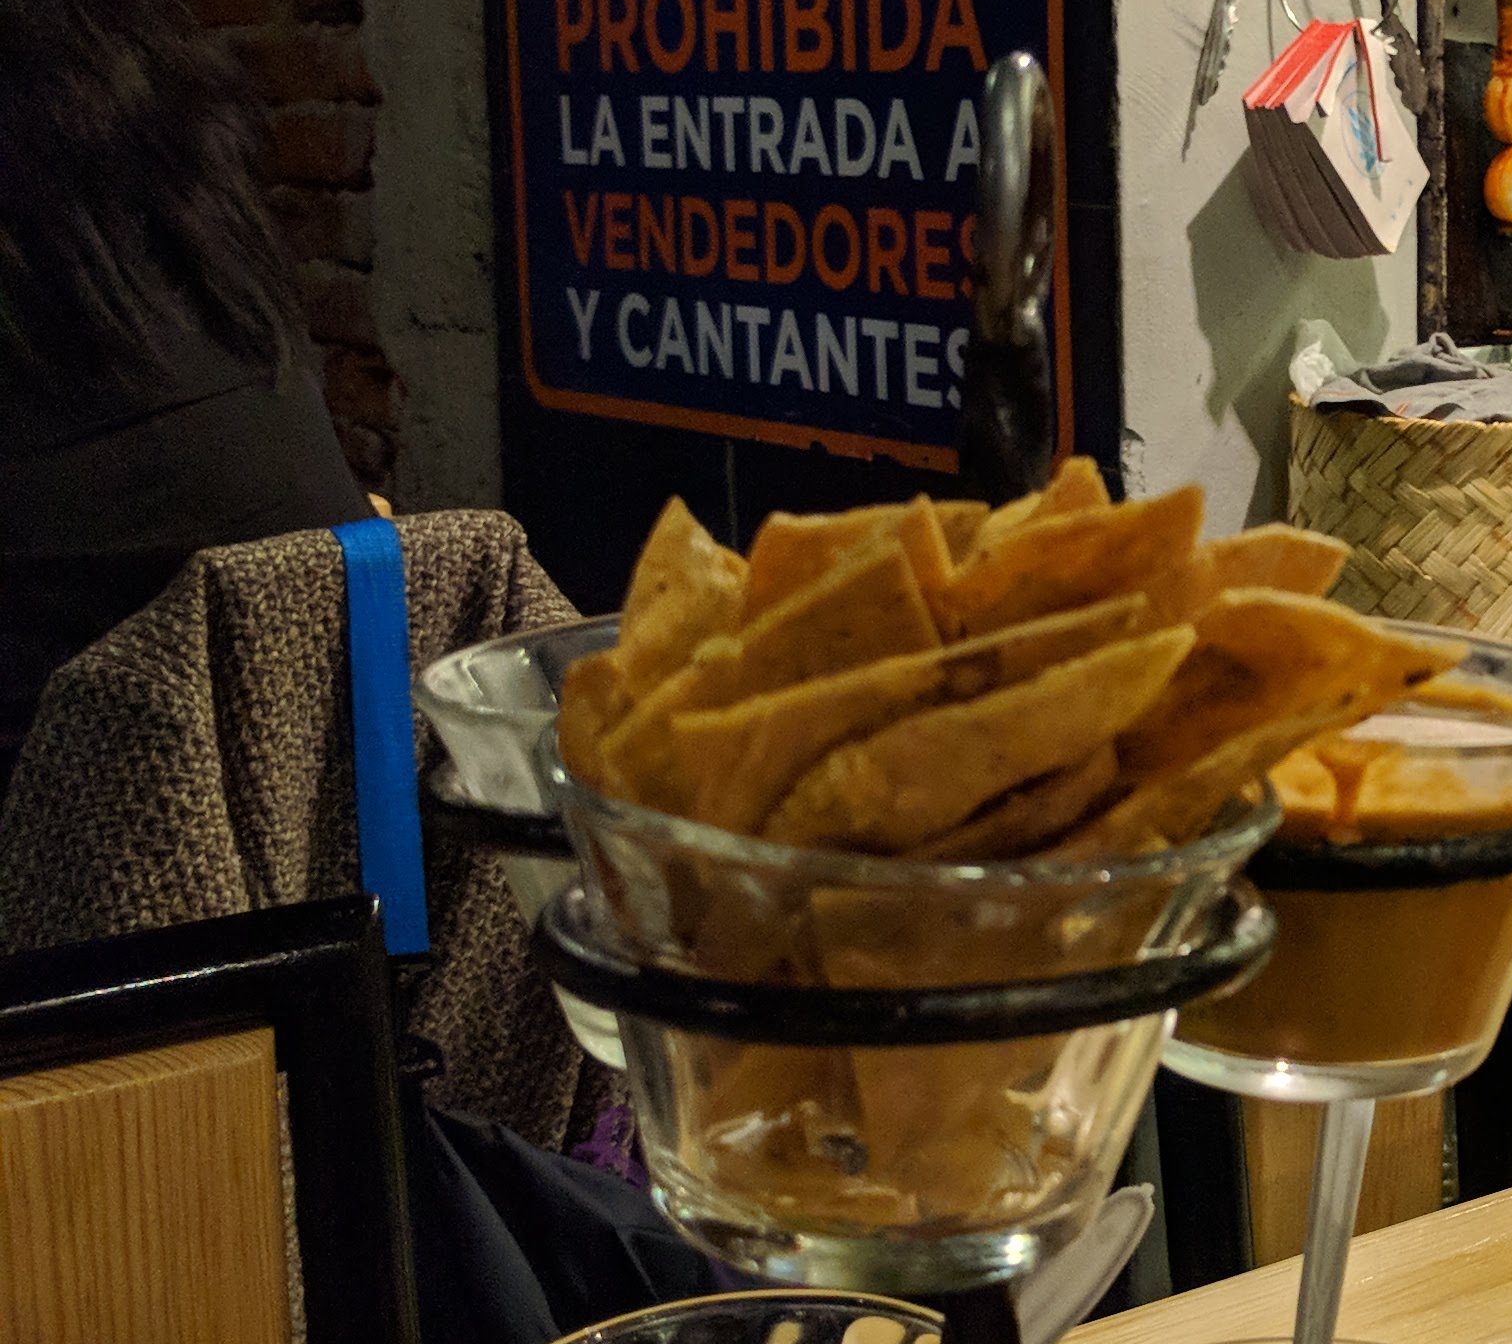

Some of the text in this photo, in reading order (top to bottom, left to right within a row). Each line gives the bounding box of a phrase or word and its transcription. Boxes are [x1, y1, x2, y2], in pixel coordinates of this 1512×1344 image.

[560, 94, 982, 182] LA ENTRADA A
[566, 287, 601, 362] Y
